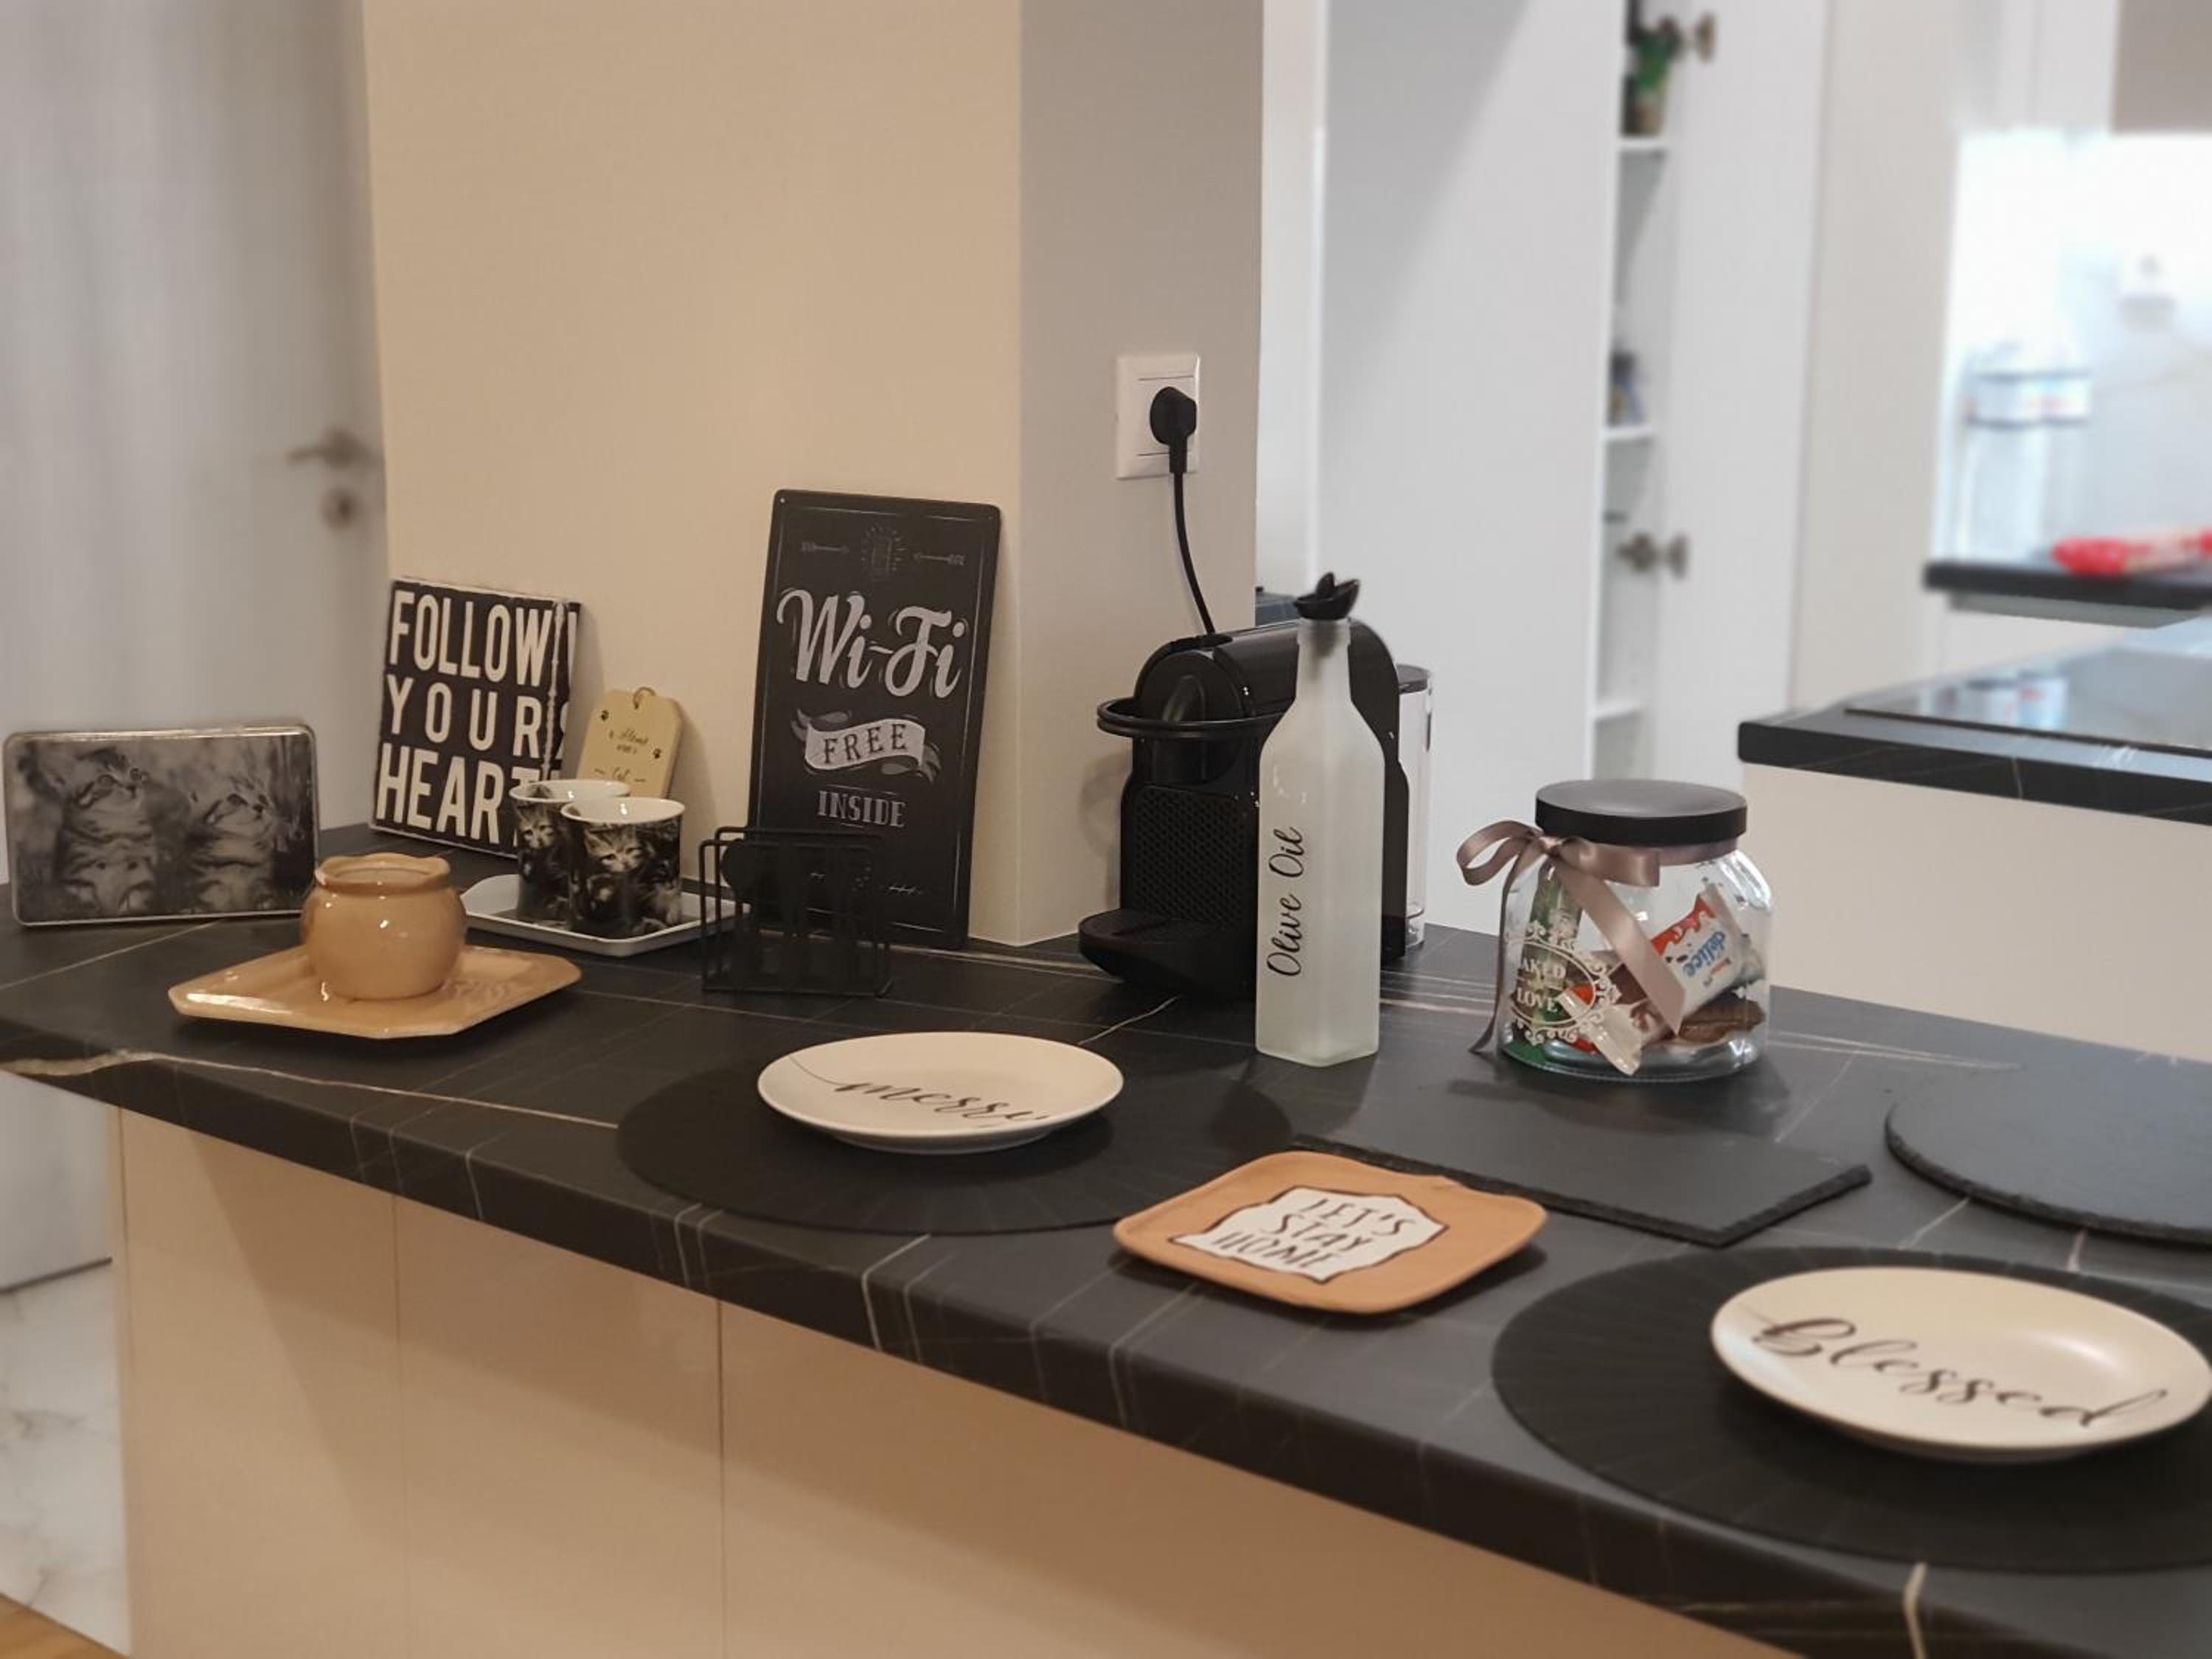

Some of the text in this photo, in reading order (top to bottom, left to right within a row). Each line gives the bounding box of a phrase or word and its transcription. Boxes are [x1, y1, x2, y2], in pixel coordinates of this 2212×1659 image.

[389, 589, 553, 688] FOLLOW
[776, 589, 968, 698] Wi-Fi
[386, 673, 542, 759] YOUR
[823, 723, 908, 765] FREE
[817, 790, 906, 828] INSIDE
[1266, 826, 1305, 977] Olive Oil
[1211, 1231, 1342, 1268] HOME
[1261, 1213, 1374, 1252] STAY
[1298, 1198, 1416, 1237] LET'S
[1739, 1304, 2168, 1427] Blessed
